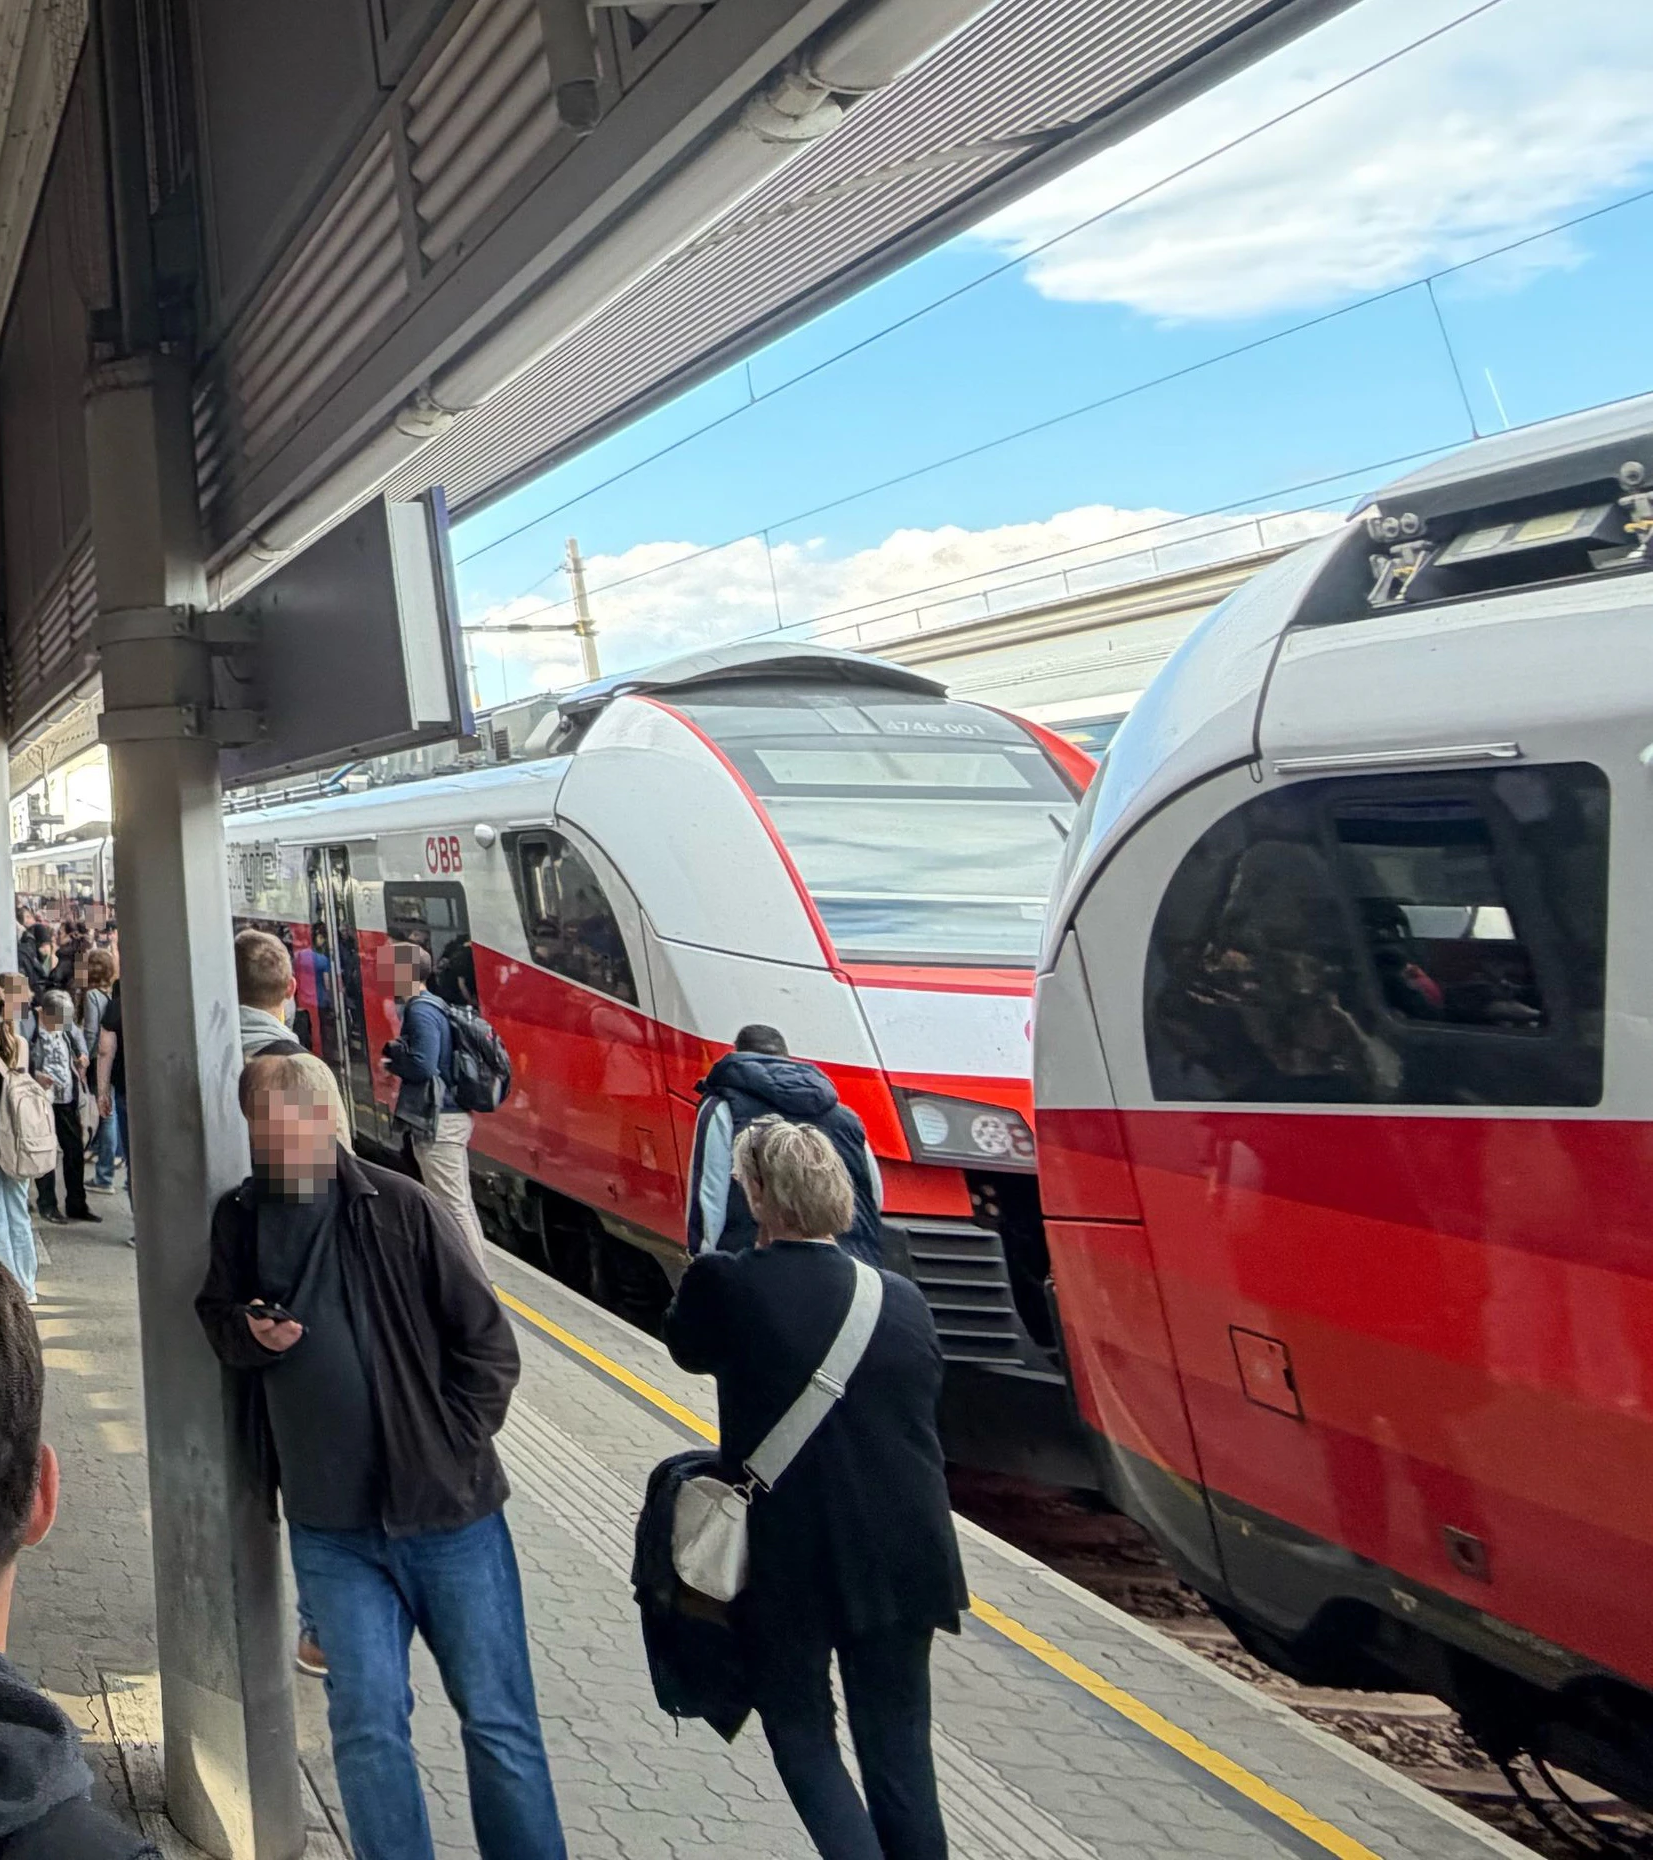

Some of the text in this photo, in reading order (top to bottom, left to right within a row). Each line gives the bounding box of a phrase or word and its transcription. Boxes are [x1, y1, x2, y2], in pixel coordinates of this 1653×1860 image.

[886, 719, 986, 736] 4746 001
[425, 835, 463, 875] ÖBB
